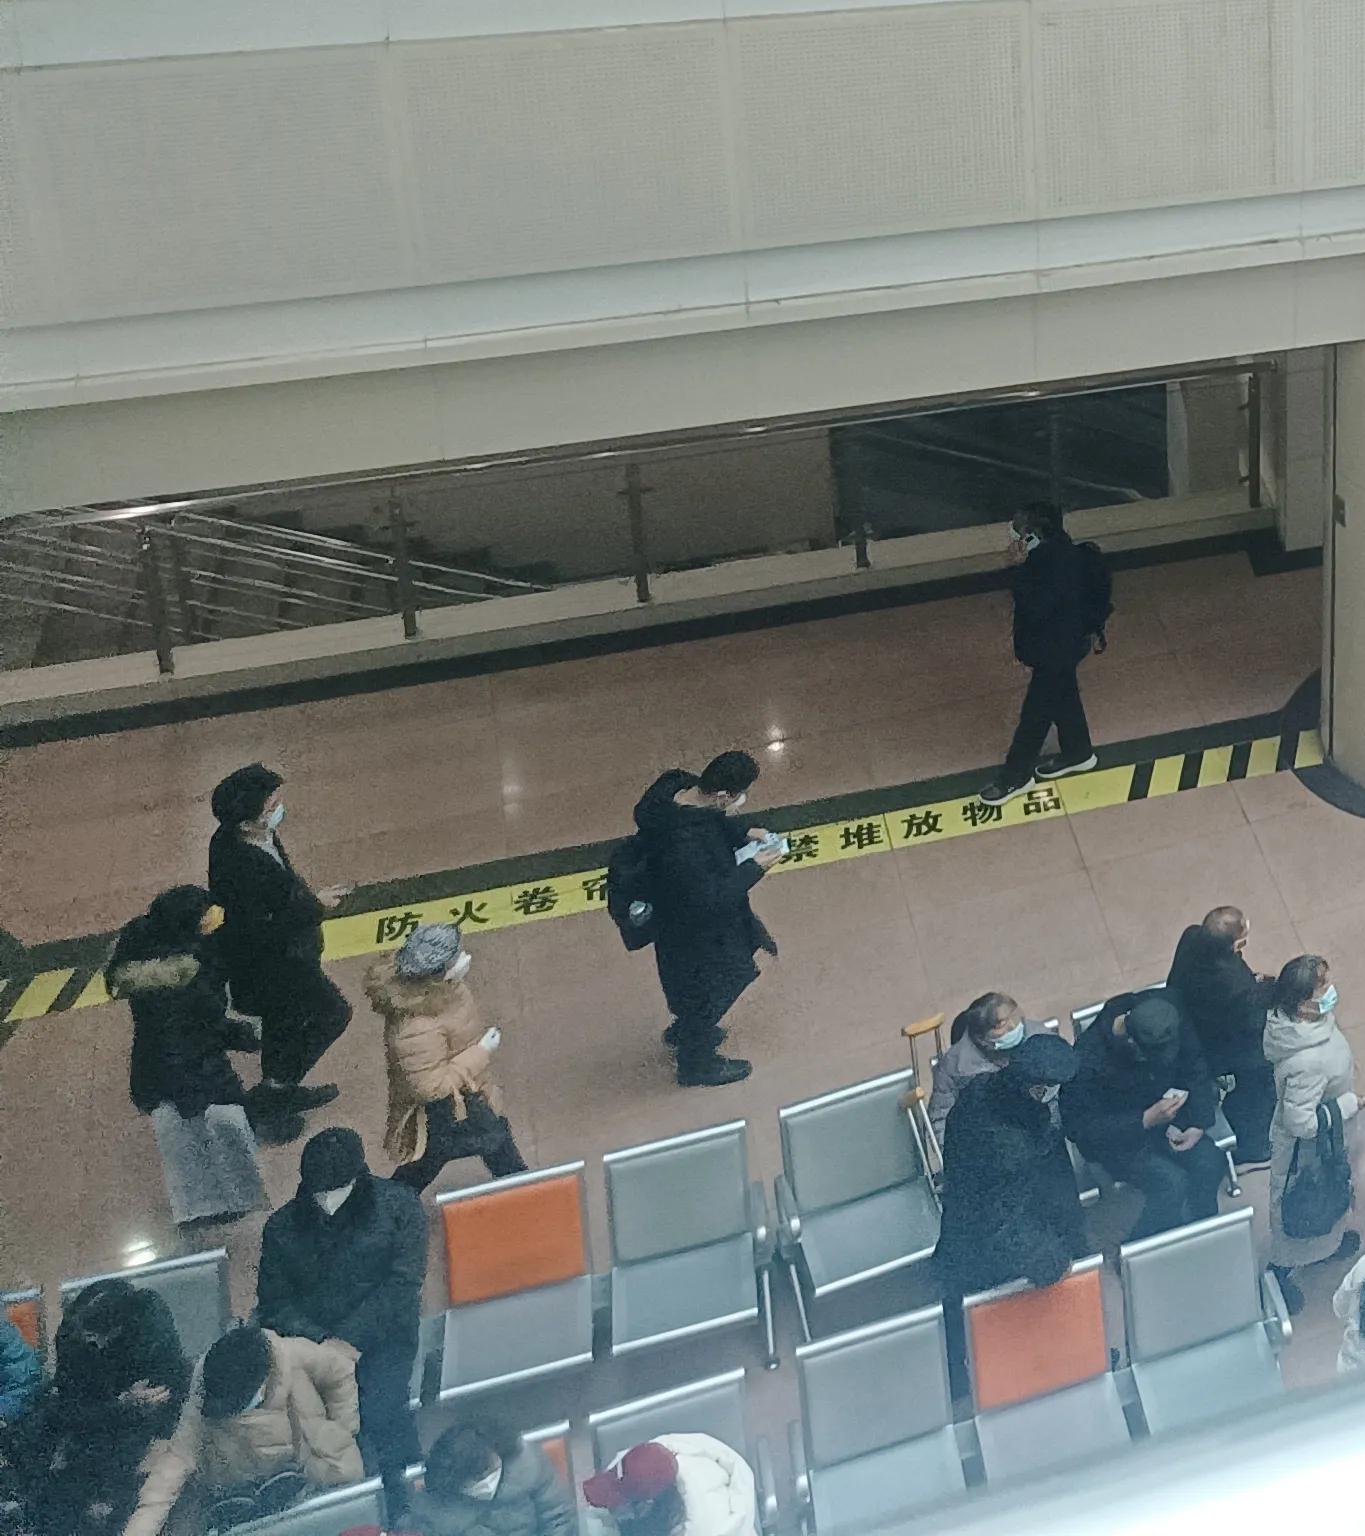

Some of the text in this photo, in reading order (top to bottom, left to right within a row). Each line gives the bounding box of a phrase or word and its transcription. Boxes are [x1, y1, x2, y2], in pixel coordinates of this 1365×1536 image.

[374, 786, 1064, 944] 防火卷帘禁堆放物品
